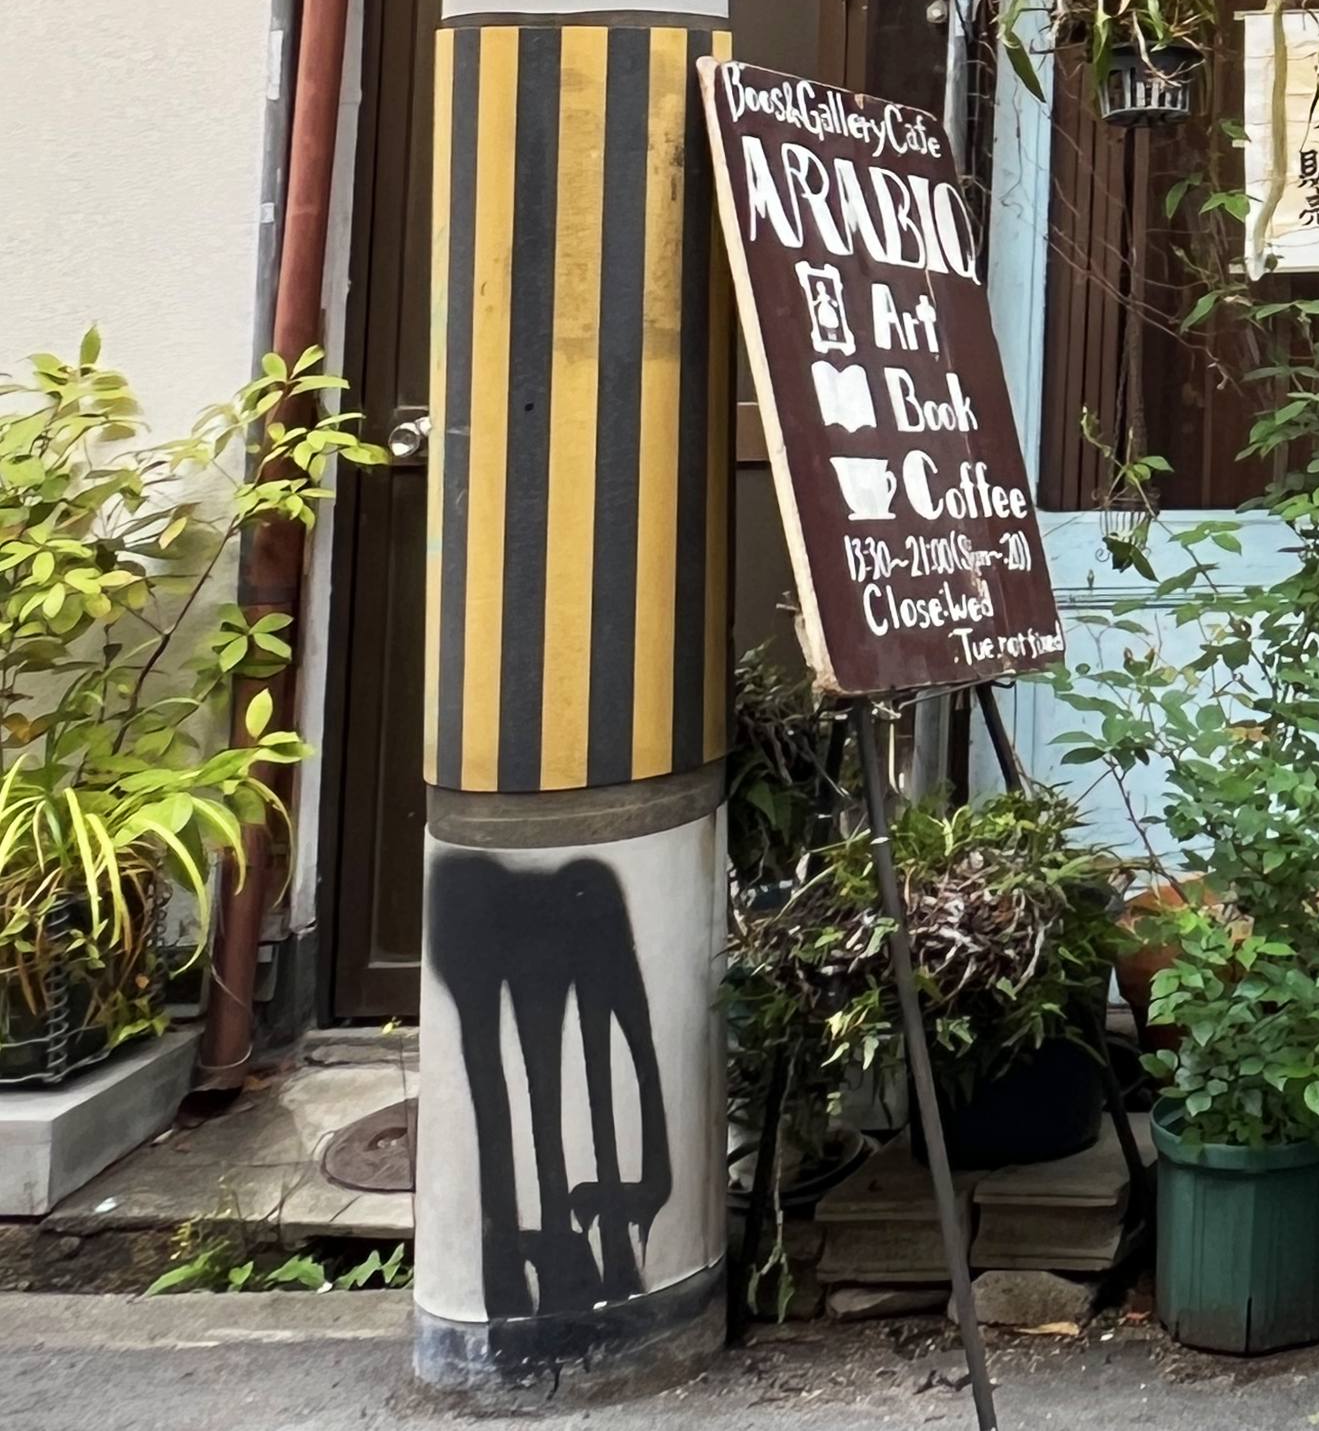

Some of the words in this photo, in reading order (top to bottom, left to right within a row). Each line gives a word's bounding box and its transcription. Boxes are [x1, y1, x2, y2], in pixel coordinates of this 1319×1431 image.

[871, 283, 940, 353] Art
[884, 367, 978, 432] Book
[903, 449, 1028, 520] Coffee
